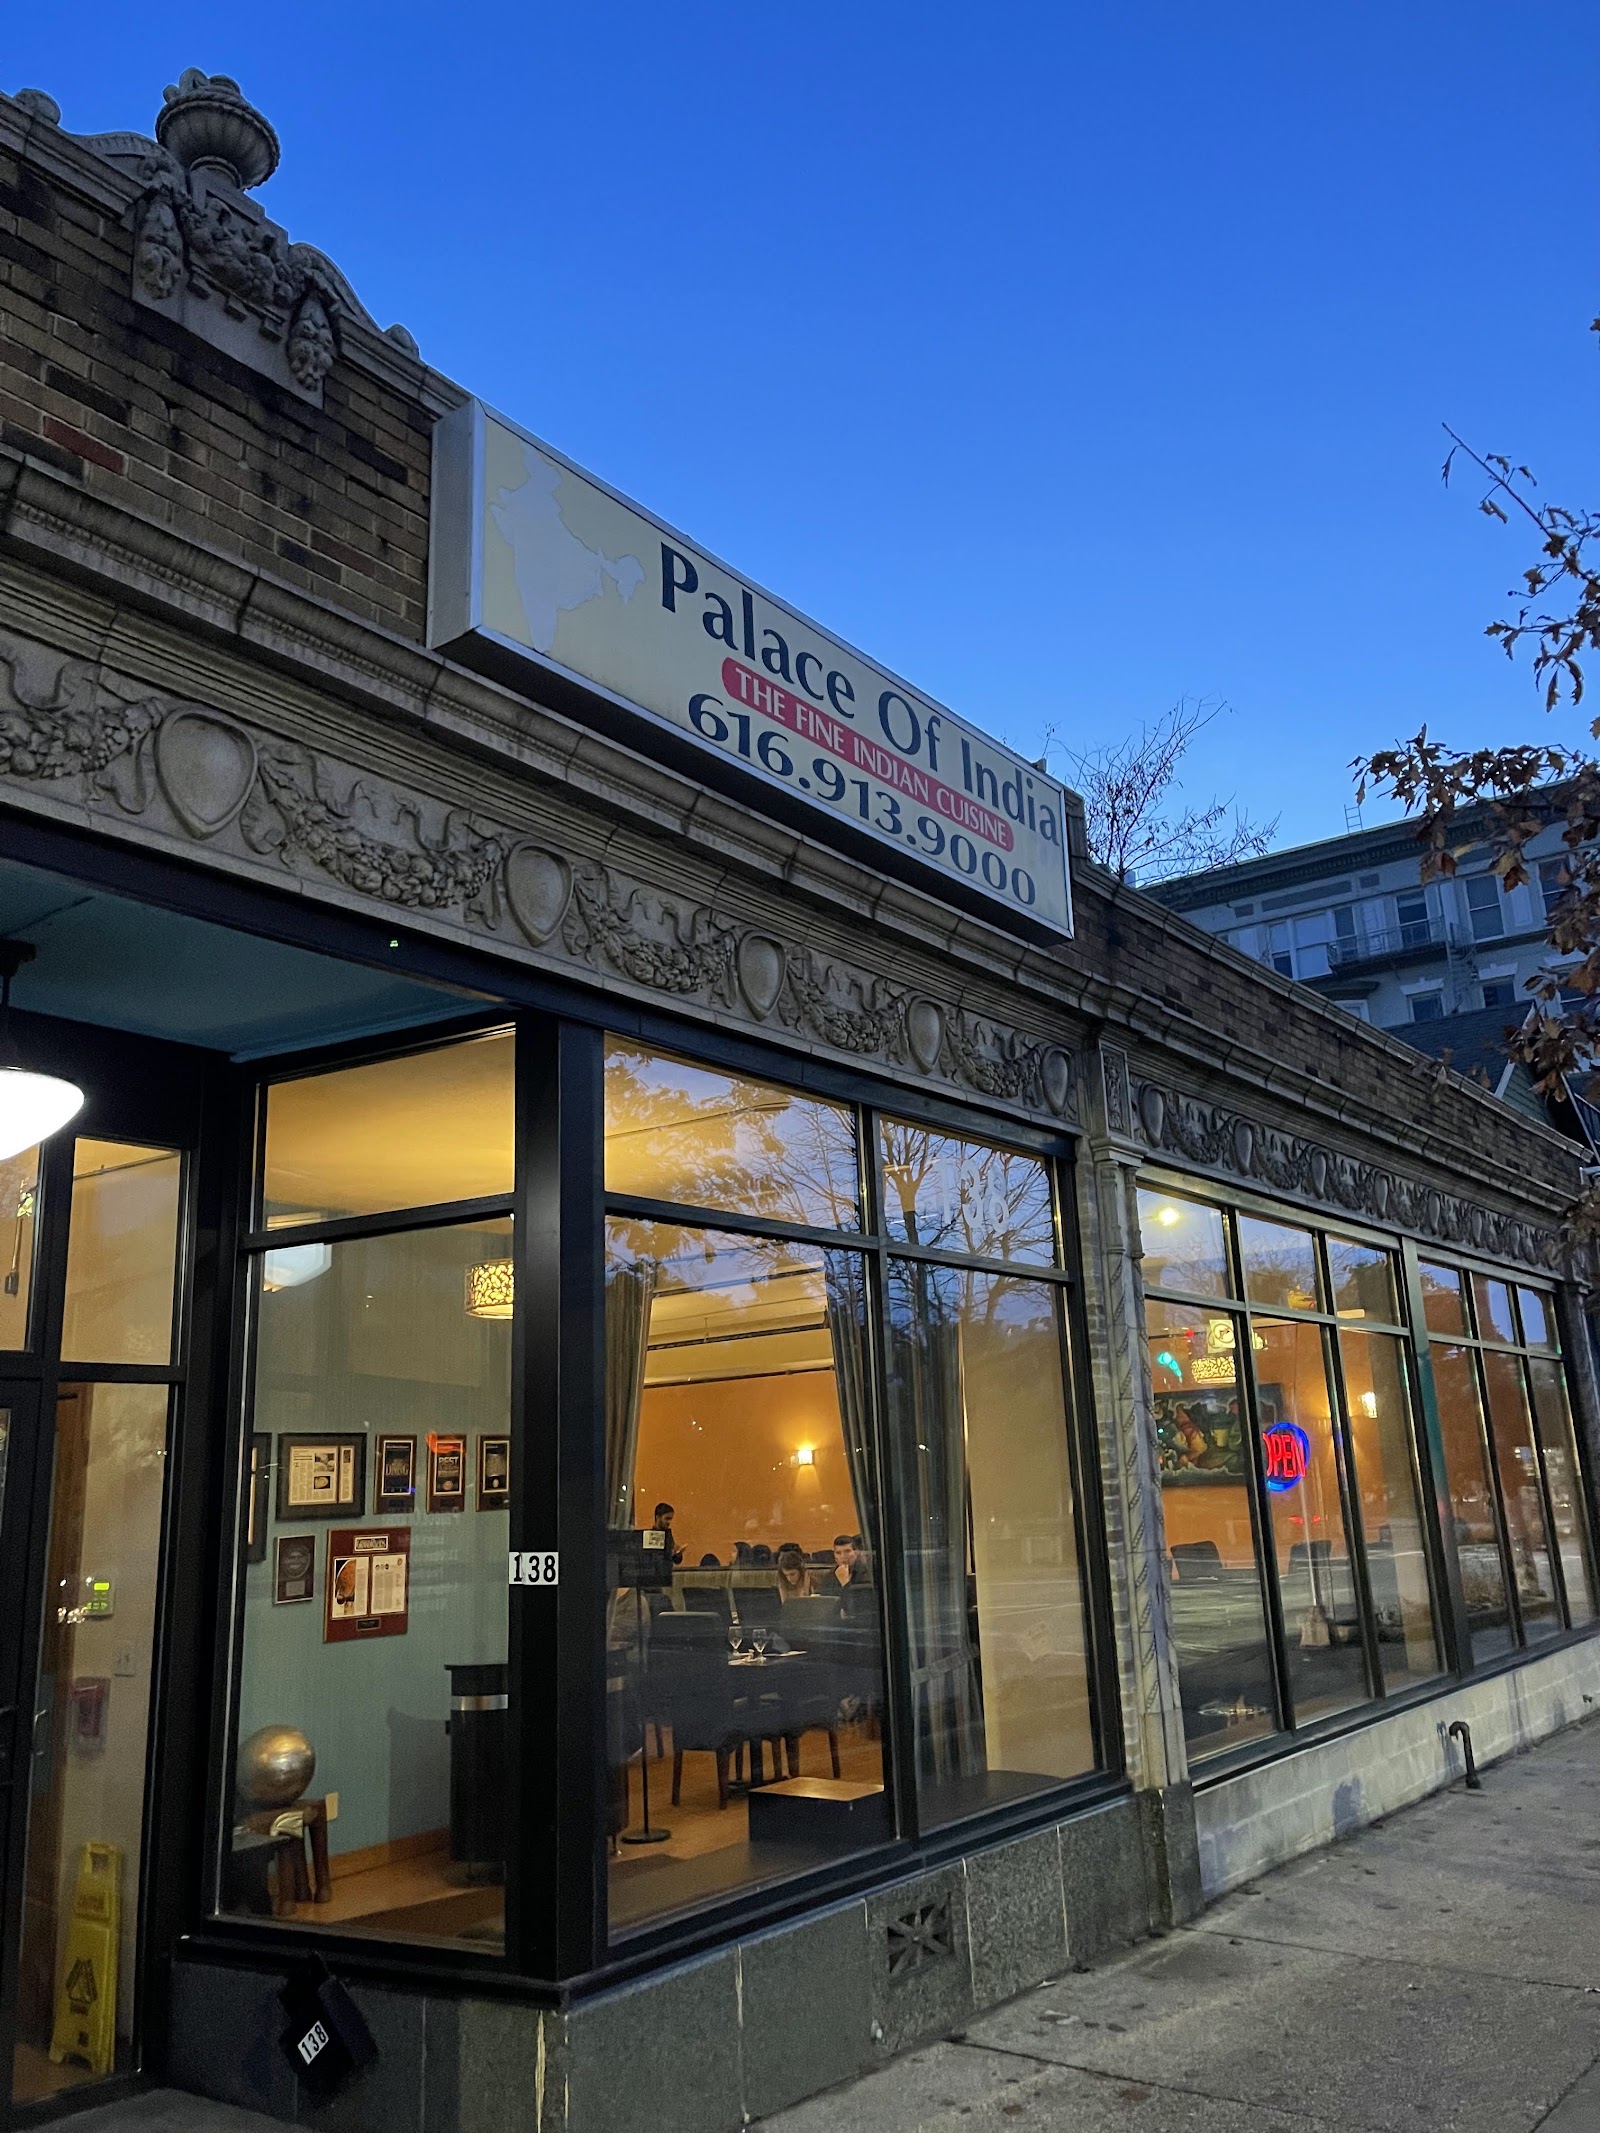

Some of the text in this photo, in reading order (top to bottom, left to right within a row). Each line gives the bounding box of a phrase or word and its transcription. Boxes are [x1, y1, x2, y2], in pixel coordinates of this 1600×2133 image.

[660, 541, 1061, 847] Palace Of India
[735, 667, 1008, 848] THE FINE INDIAN CUISINE
[688, 693, 1036, 906] 616.913.9000
[933, 1157, 1010, 1238] 138
[513, 1554, 556, 1583] 138
[301, 2024, 327, 2060] 138
